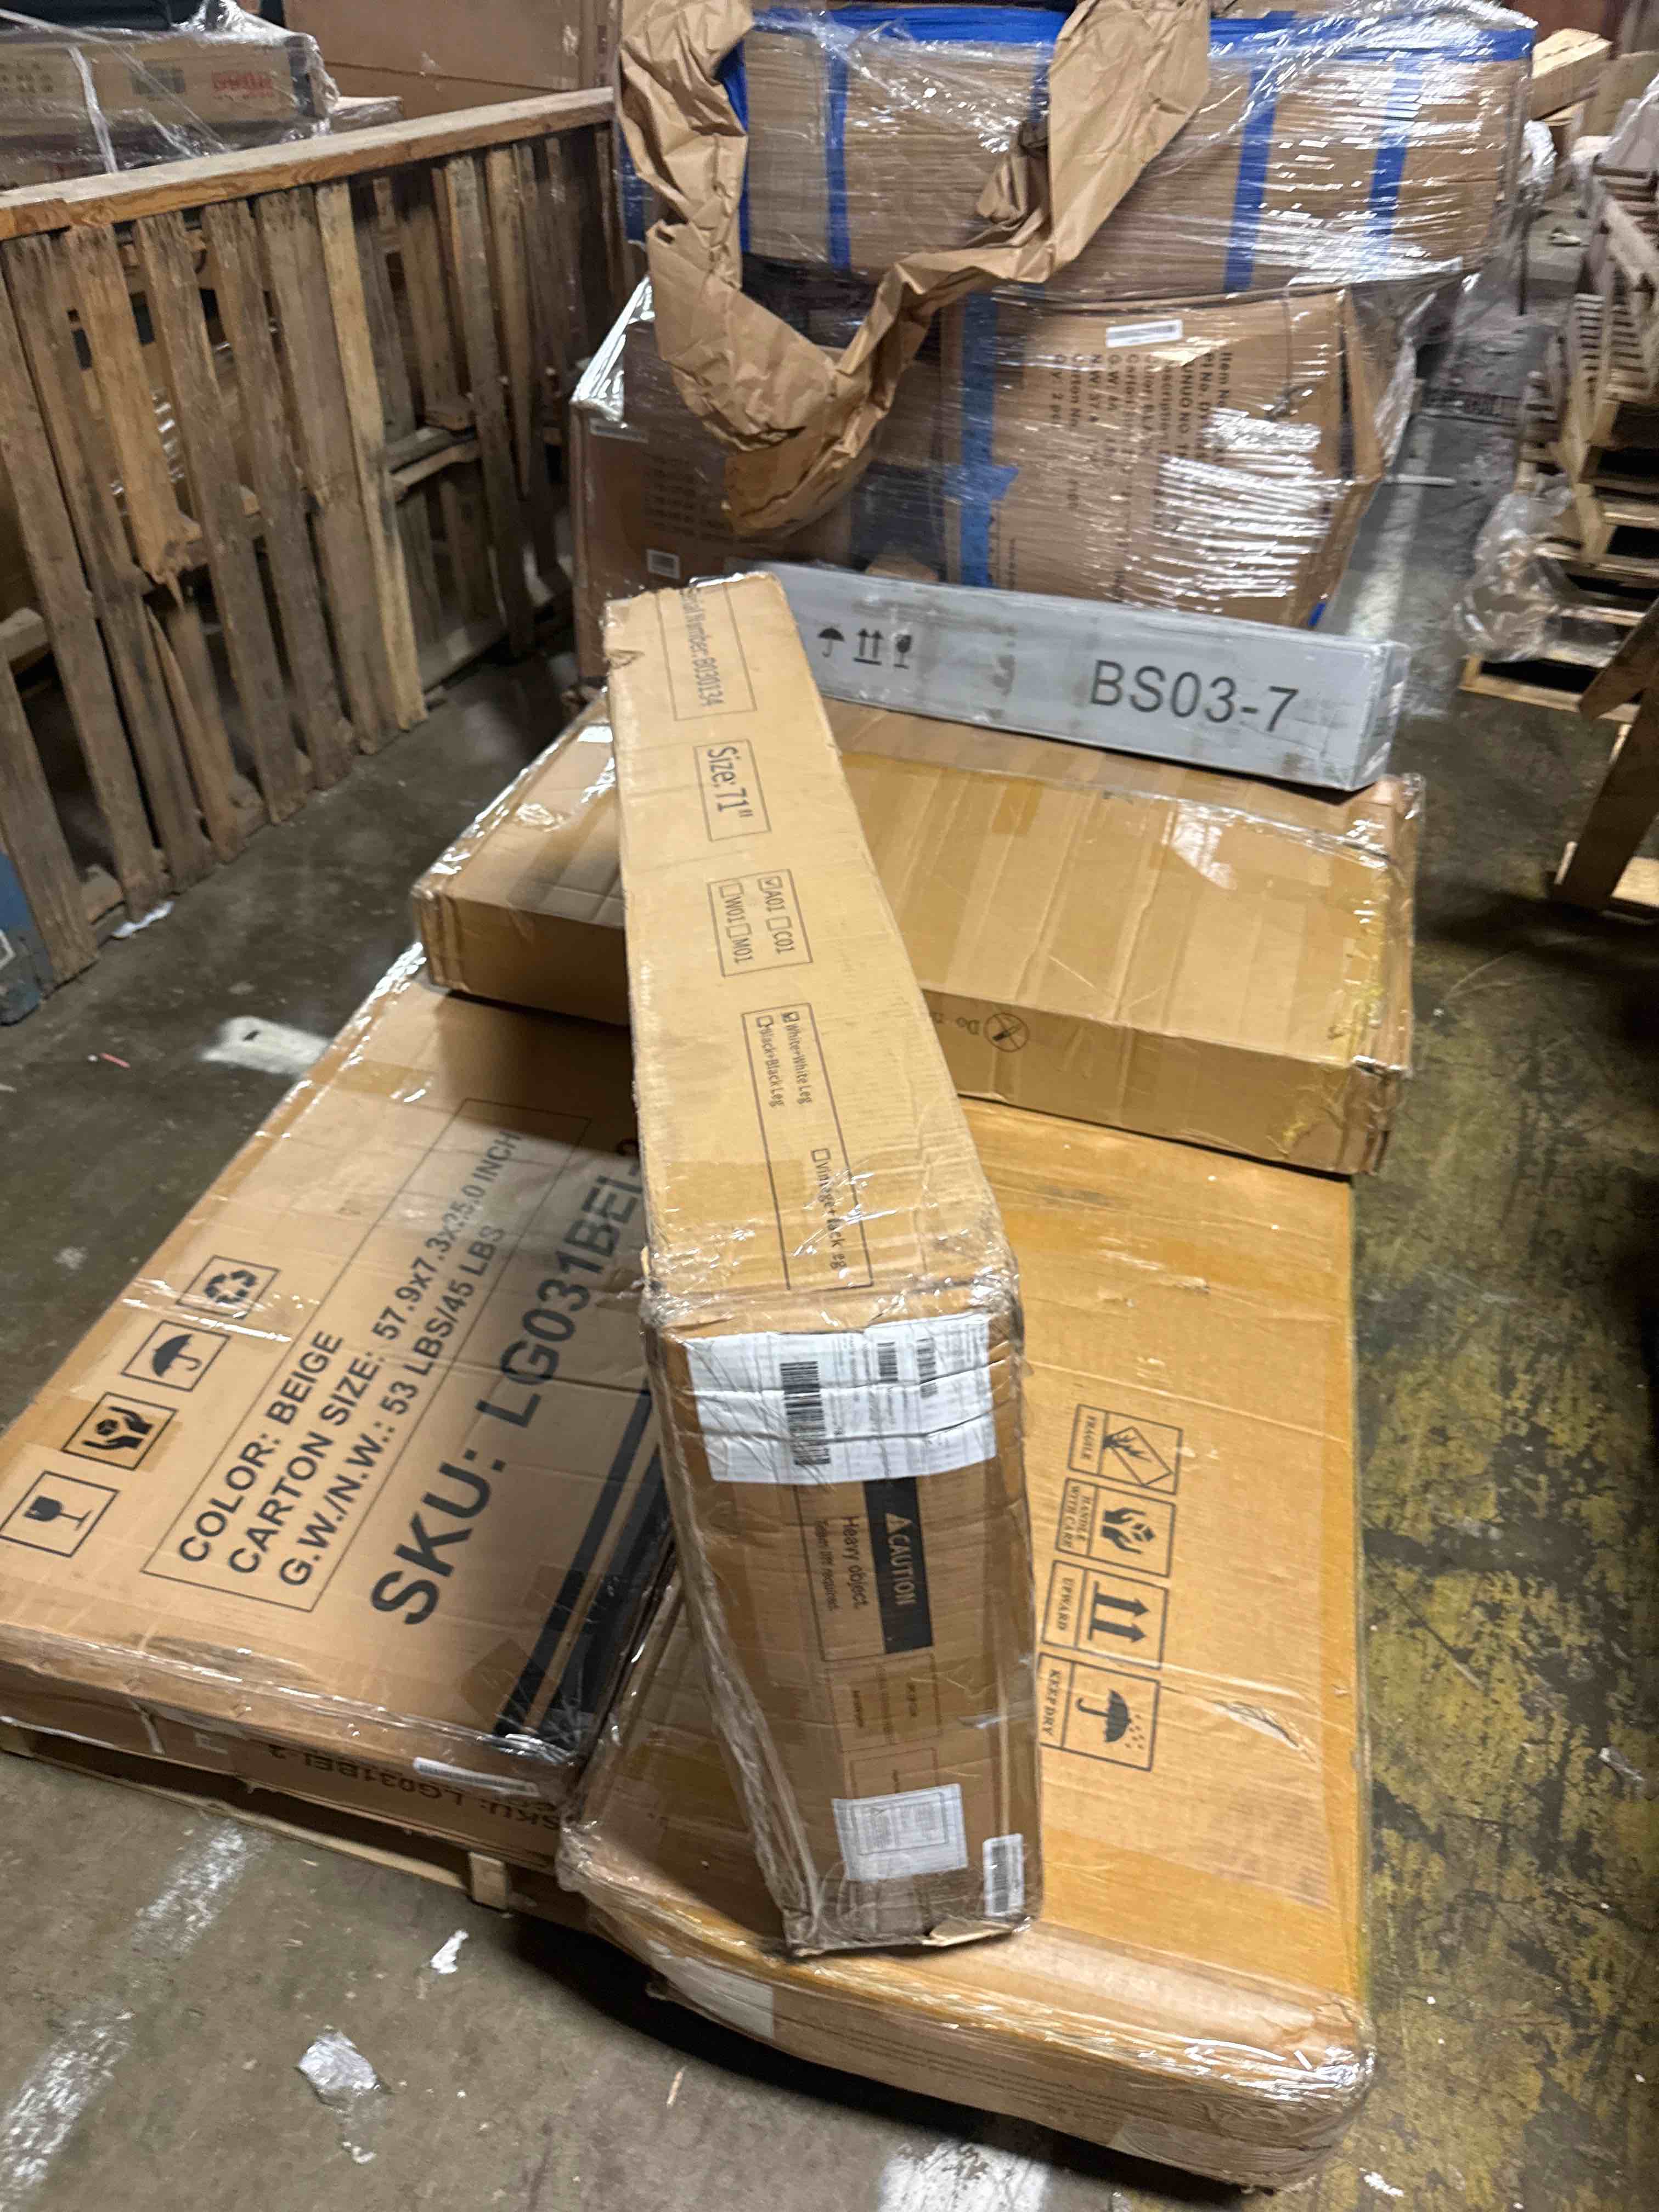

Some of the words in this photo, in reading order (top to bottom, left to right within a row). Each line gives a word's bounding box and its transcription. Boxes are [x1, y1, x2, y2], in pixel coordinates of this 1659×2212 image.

[1090, 659, 1299, 732] BS03-7
[379, 1380, 419, 1416] 53
[403, 1279, 475, 1376] LBS/45
[458, 1224, 506, 1277] LBS
[228, 1431, 335, 1573] CARTON
[319, 1351, 386, 1426] SIZE:
[471, 1131, 522, 1183] INCH
[178, 1433, 281, 1562] COLOR:
[265, 1330, 343, 1426] BEIGE
[1080, 1415, 1097, 1460] FRAGILE
[1066, 1486, 1080, 1510] WITH
[1077, 1494, 1092, 1541] HANDLE
[370, 1447, 507, 1626] SKU:
[843, 1515, 861, 1561] Heavy
[847, 1564, 869, 1609] object
[887, 1534, 918, 1606] CAUTION
[1056, 1577, 1075, 1631] UPWARD
[1046, 1668, 1062, 1705] KEEP
[1042, 1705, 1056, 1736] DRY
